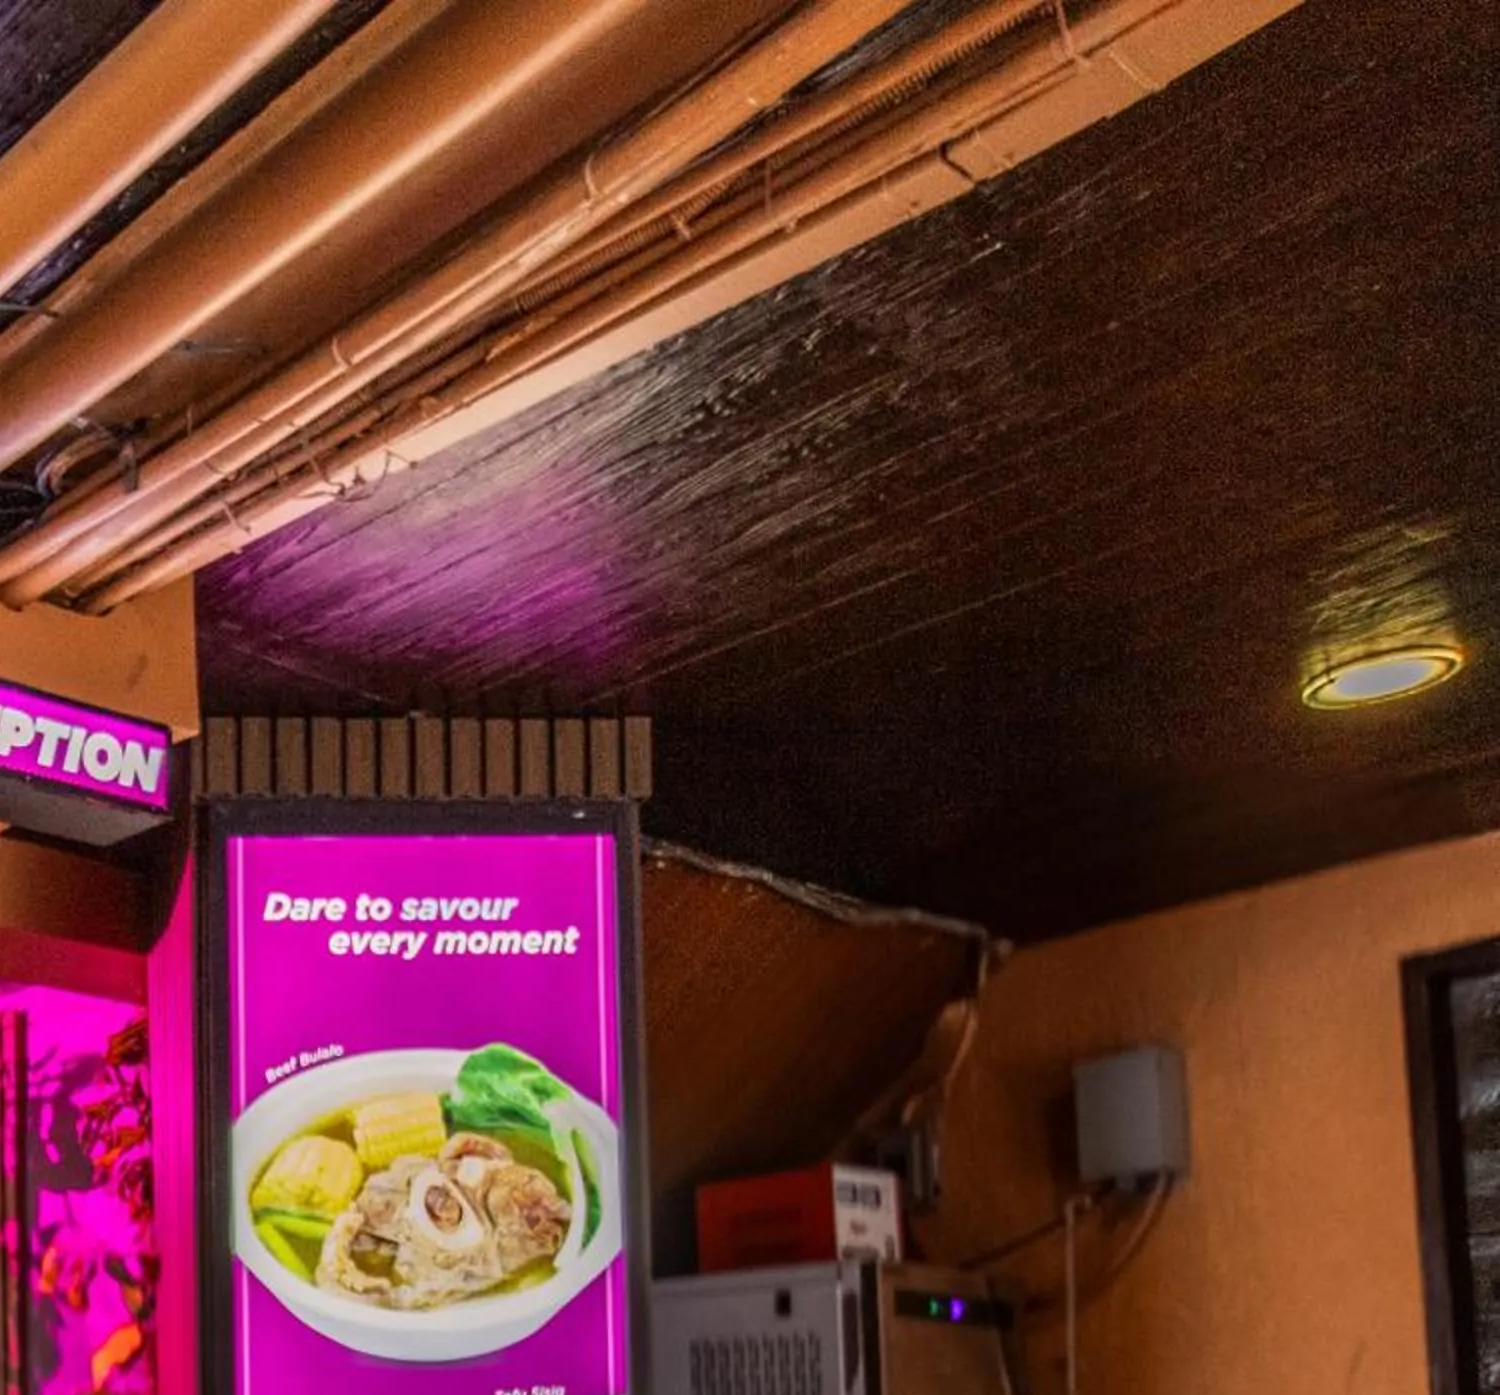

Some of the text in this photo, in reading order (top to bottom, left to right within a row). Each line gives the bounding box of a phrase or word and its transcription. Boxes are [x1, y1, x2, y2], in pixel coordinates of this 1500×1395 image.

[263, 892, 519, 922] Dare to savour
[328, 926, 580, 960] every moment
[265, 1043, 344, 1083] Beef Bulalo
